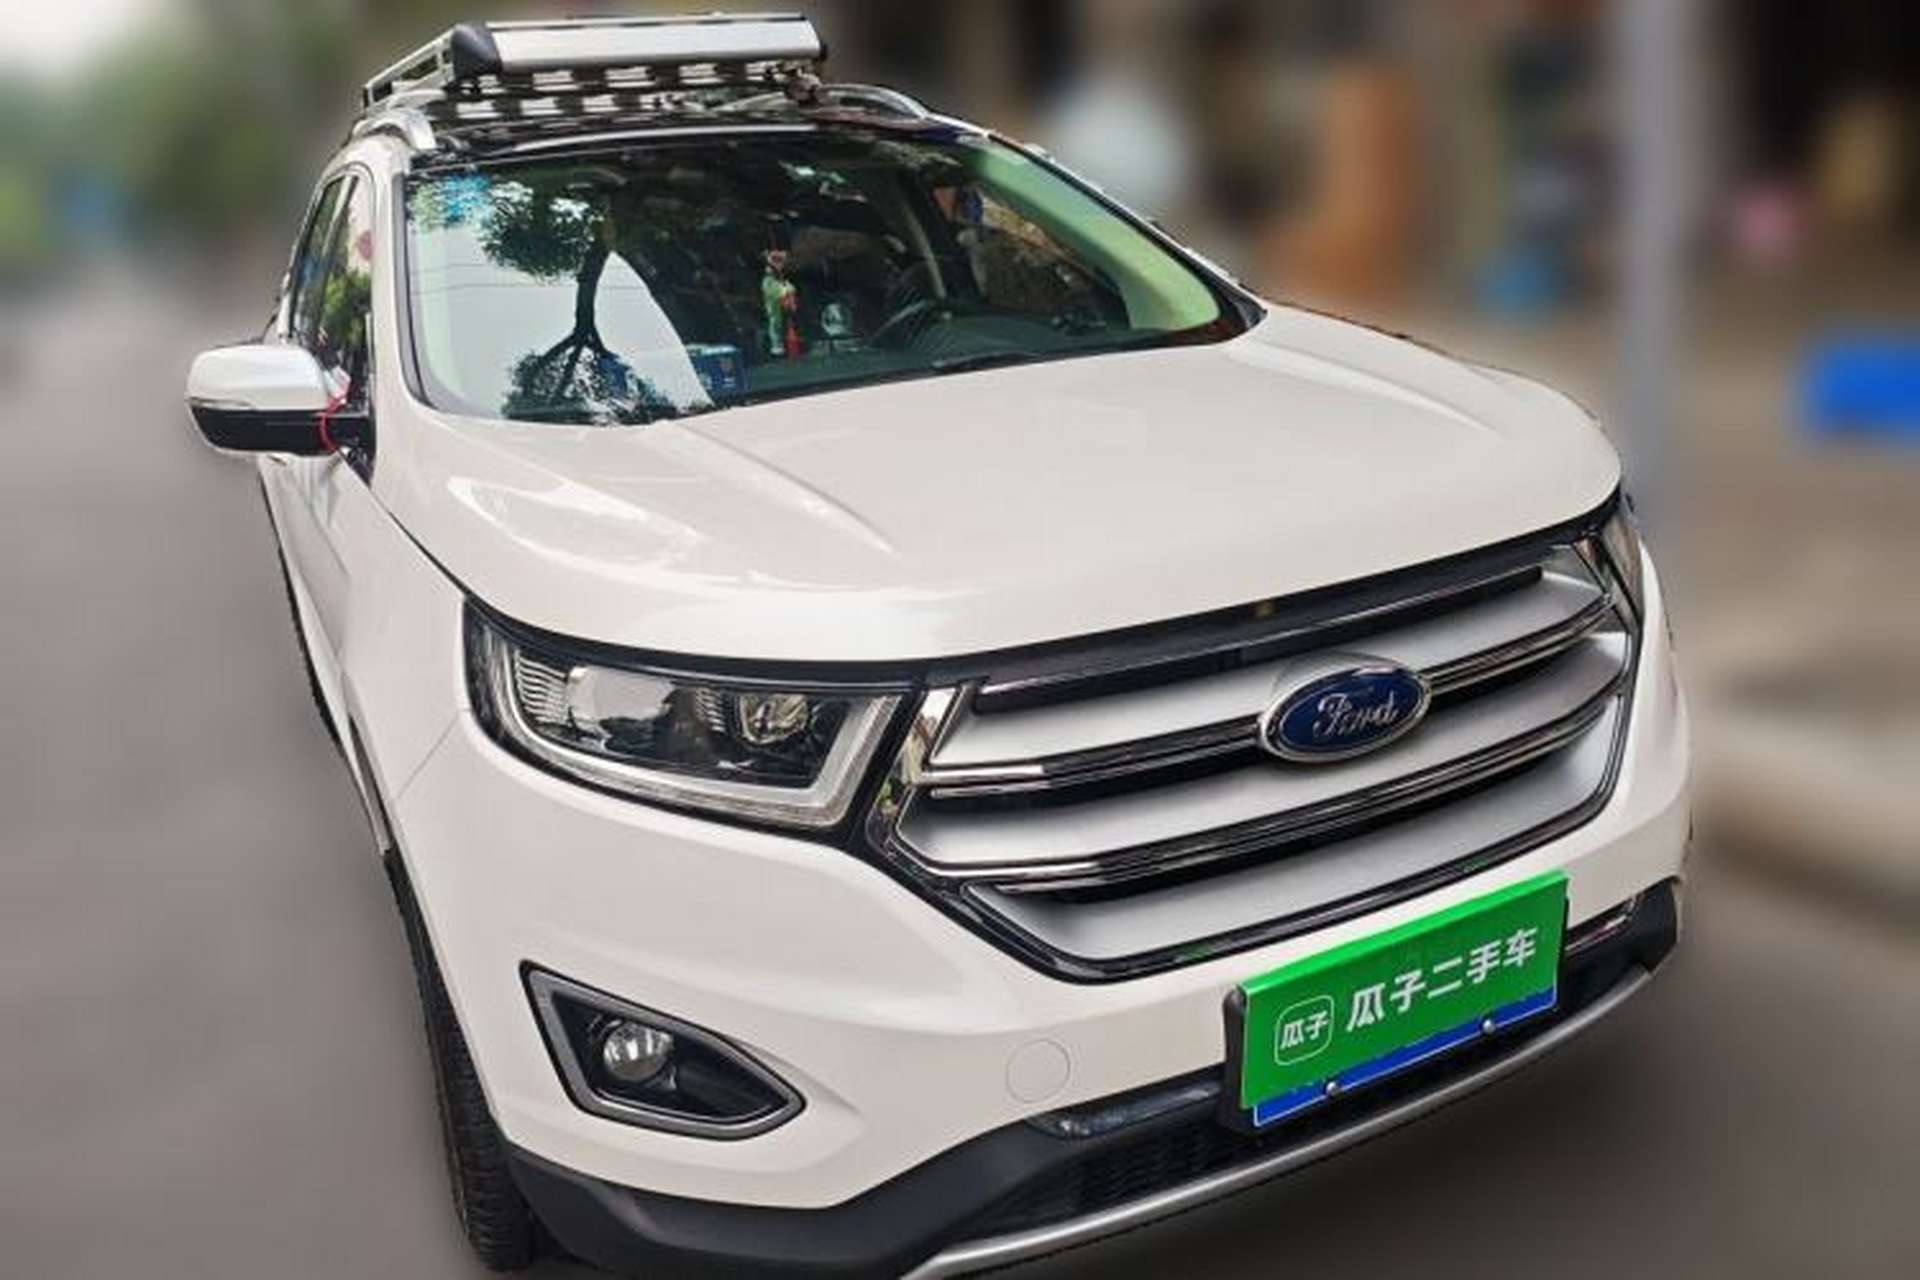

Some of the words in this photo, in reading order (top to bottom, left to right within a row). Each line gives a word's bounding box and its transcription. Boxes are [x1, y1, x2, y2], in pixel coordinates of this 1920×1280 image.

[1312, 691, 1399, 736] Ford
[1346, 928, 1537, 1032] 瓜子二手车
[1280, 1010, 1329, 1049] 瓜子
